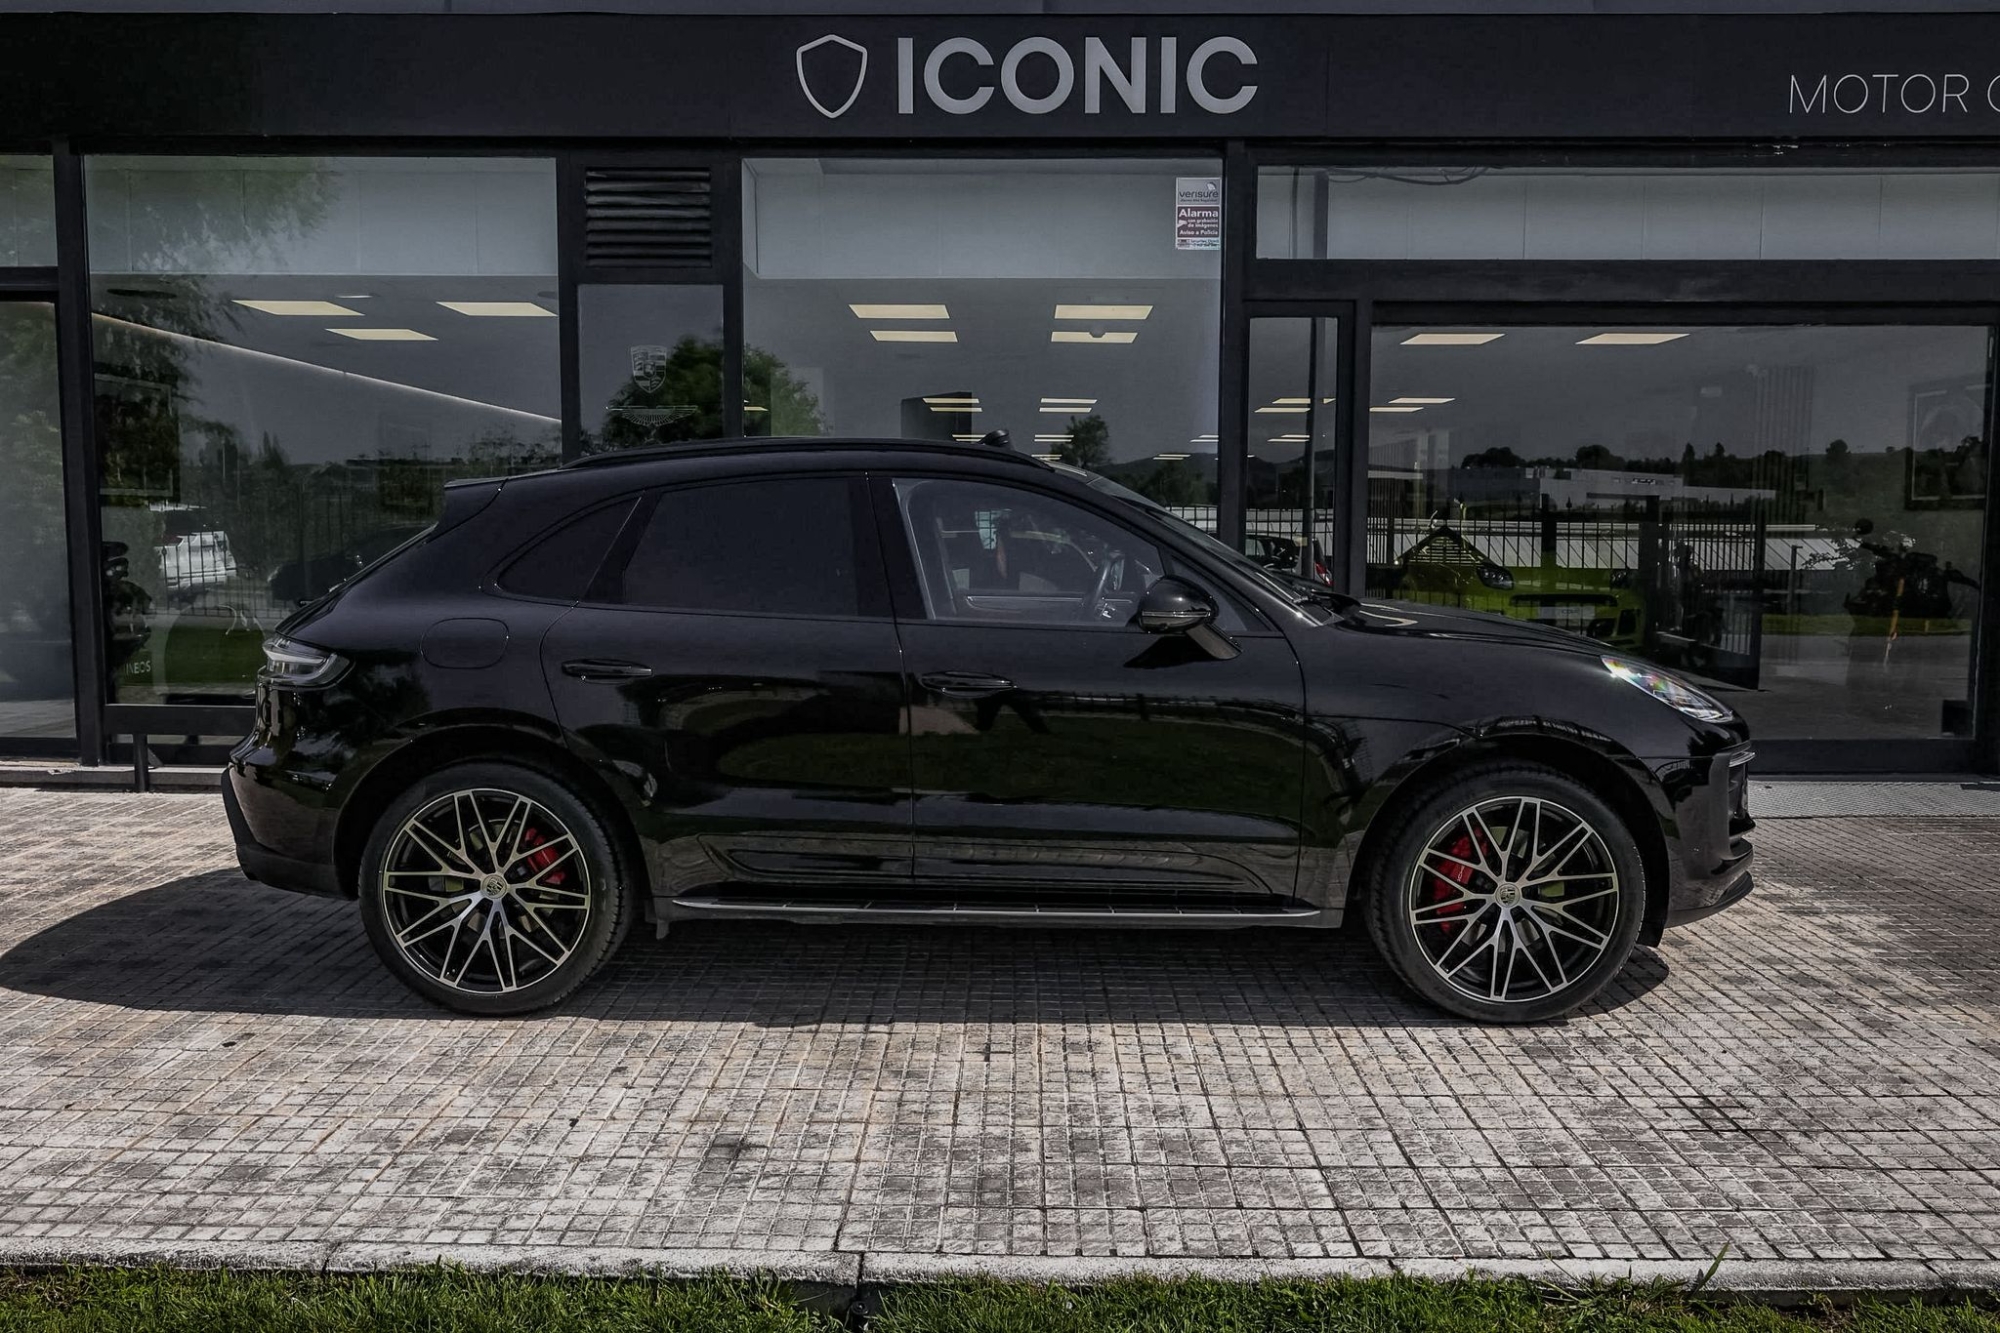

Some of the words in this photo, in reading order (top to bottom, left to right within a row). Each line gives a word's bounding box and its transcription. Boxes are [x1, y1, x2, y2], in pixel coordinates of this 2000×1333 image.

[897, 36, 1258, 115] ICONIC
[1789, 74, 1969, 114] MOTOR
[1179, 208, 1218, 217] Alarma
